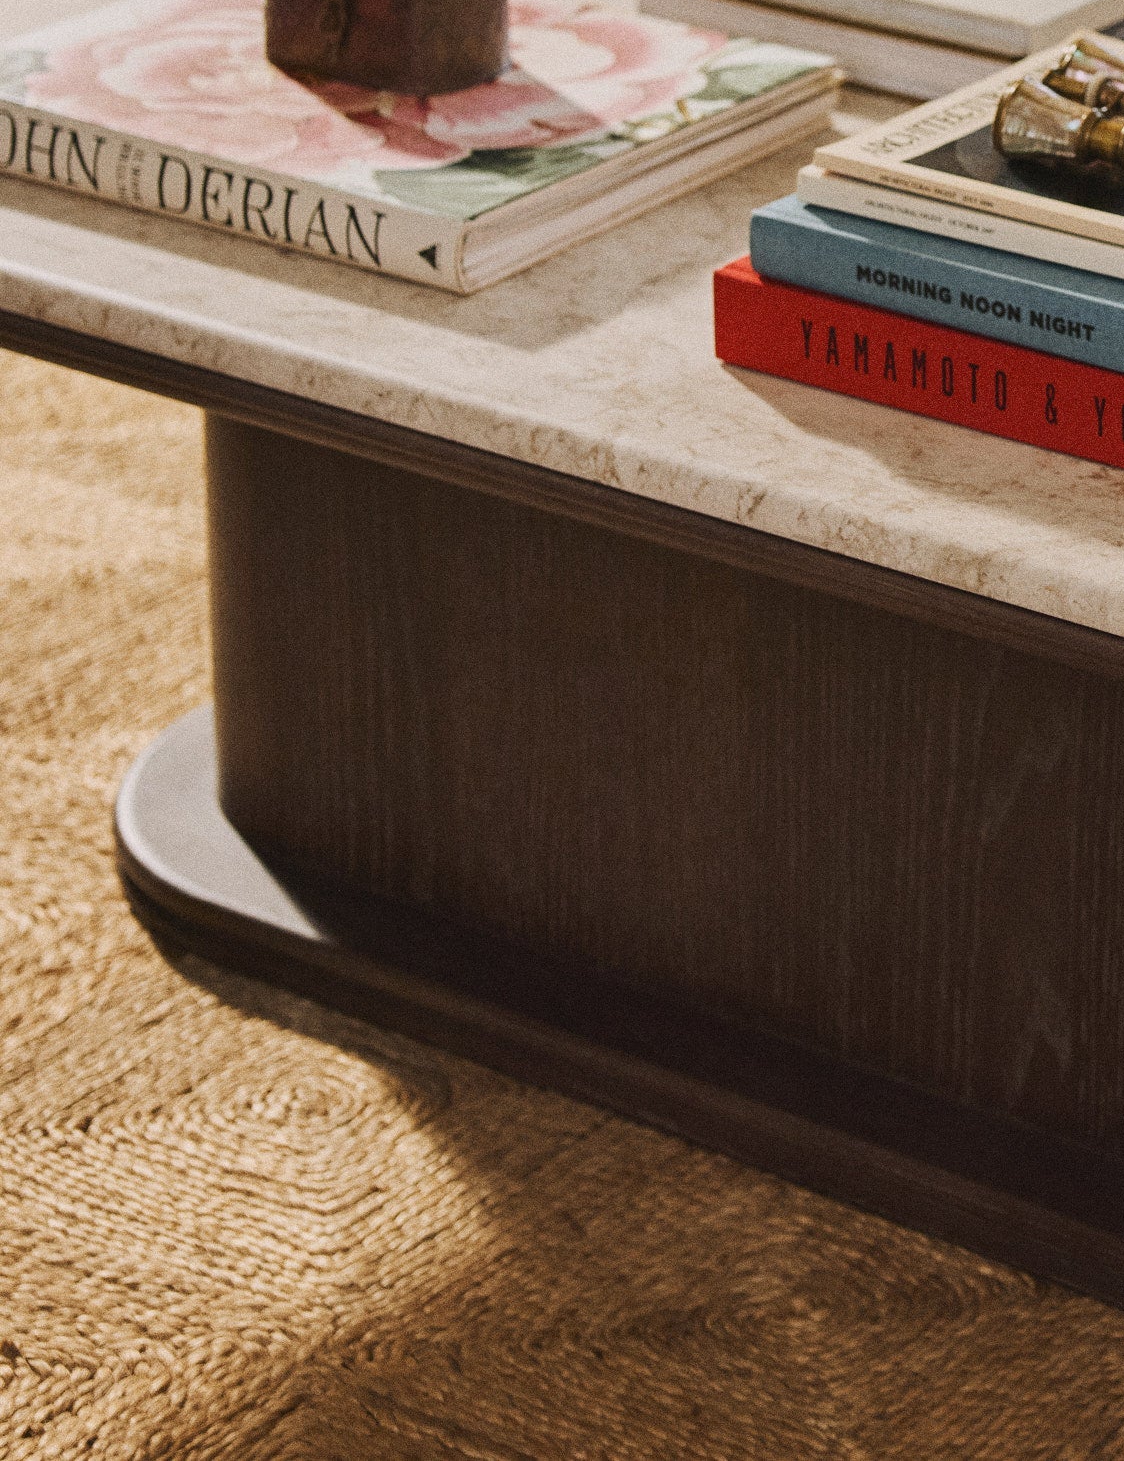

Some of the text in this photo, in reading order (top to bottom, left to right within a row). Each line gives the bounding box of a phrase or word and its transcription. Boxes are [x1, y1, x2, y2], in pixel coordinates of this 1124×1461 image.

[157, 153, 387, 267] DERIAN
[856, 265, 1096, 342] MORNING NOON NIGHT
[801, 318, 1007, 412] YAMAMOTO
[1044, 383, 1059, 426] &
